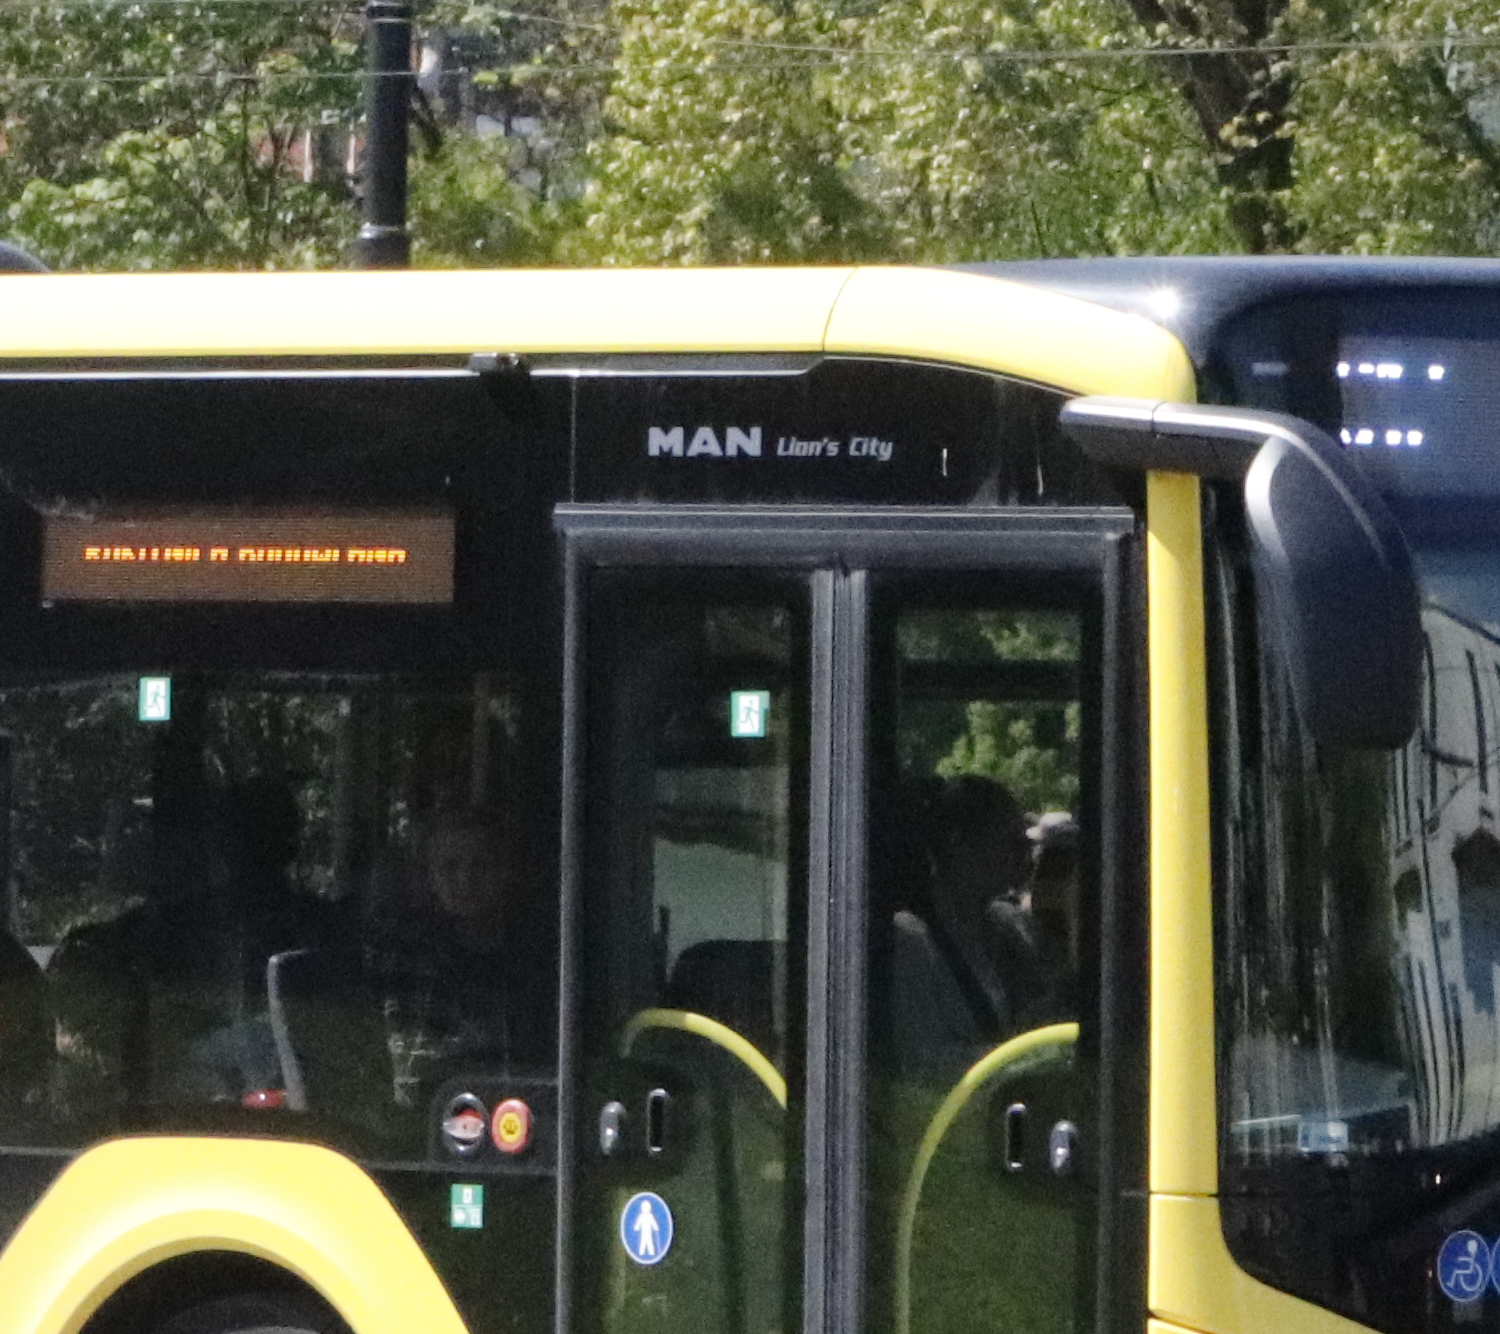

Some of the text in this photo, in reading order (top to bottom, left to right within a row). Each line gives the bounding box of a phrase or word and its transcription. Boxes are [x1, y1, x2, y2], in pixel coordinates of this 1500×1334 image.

[648, 426, 893, 461] MAN Lion's City
